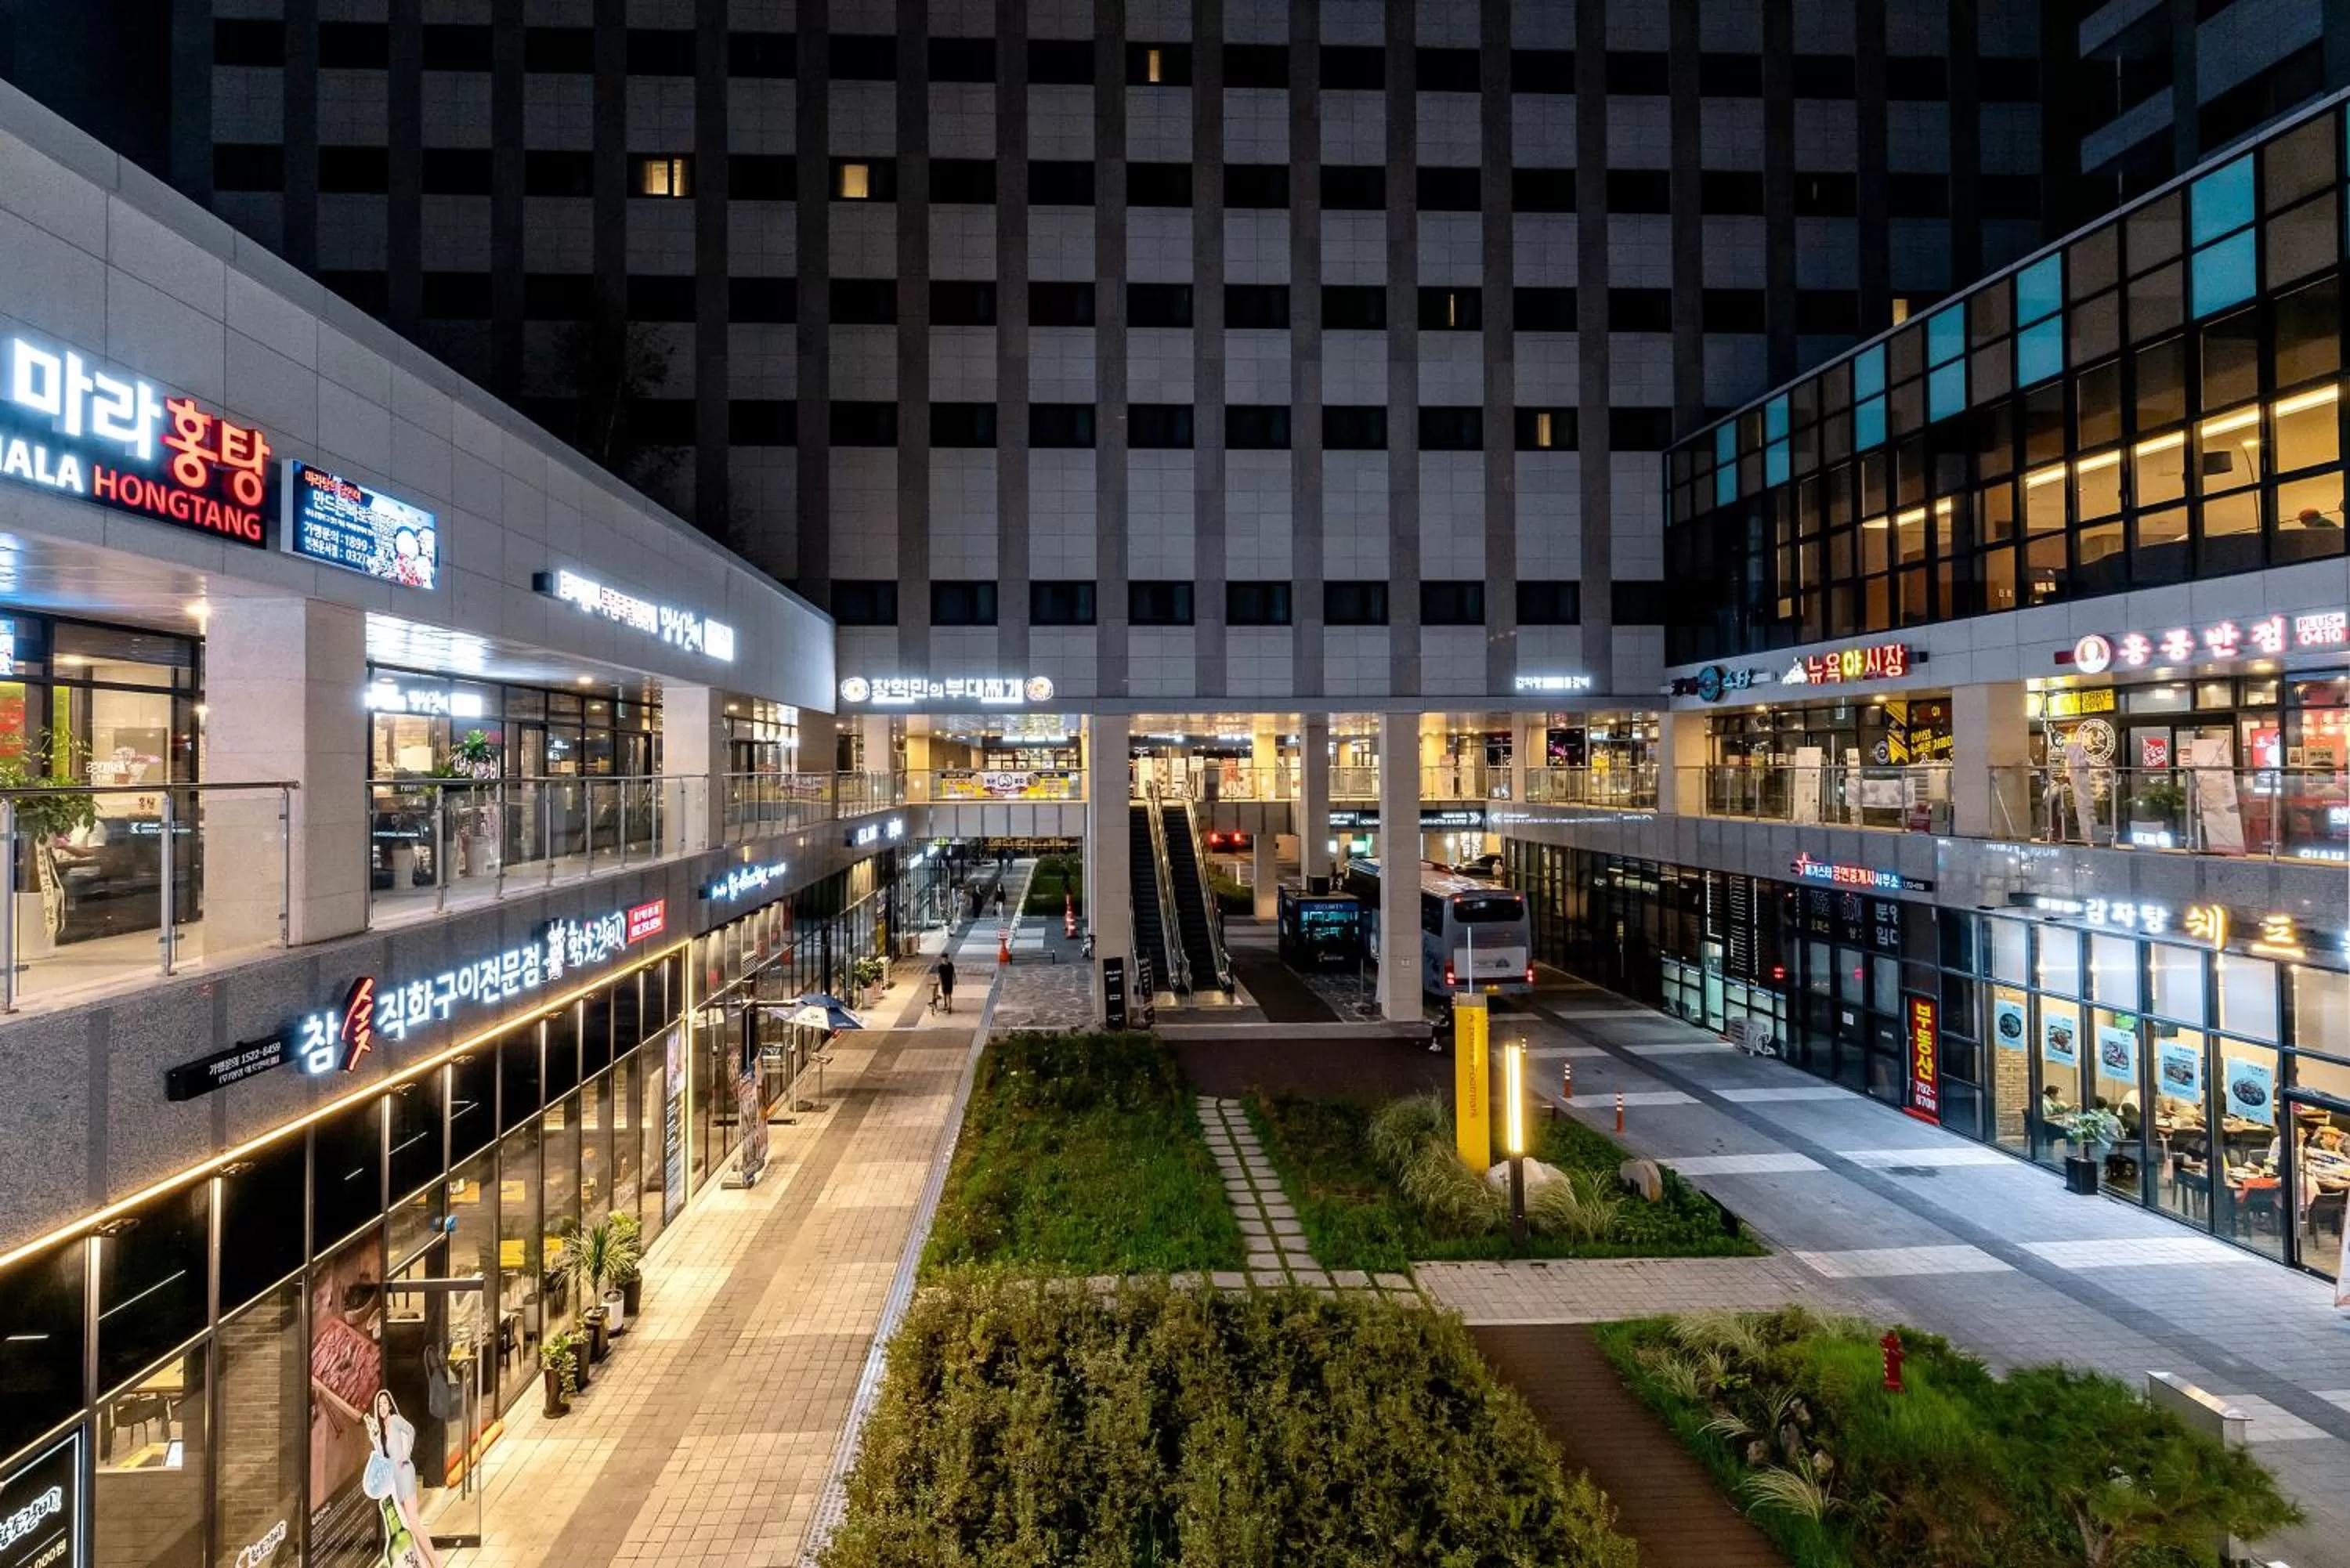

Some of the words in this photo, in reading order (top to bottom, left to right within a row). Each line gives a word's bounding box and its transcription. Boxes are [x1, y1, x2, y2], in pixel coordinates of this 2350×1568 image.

[0, 434, 84, 493] ALA
[94, 464, 261, 540] HONGTANG
[1808, 645, 1905, 685] 뉴욕야시장
[2119, 616, 2286, 665] 홍콩반점
[2086, 898, 2168, 933] 감자탕
[377, 943, 540, 1042] 직화구이전문점
[1915, 1003, 1934, 1082] 부동산
